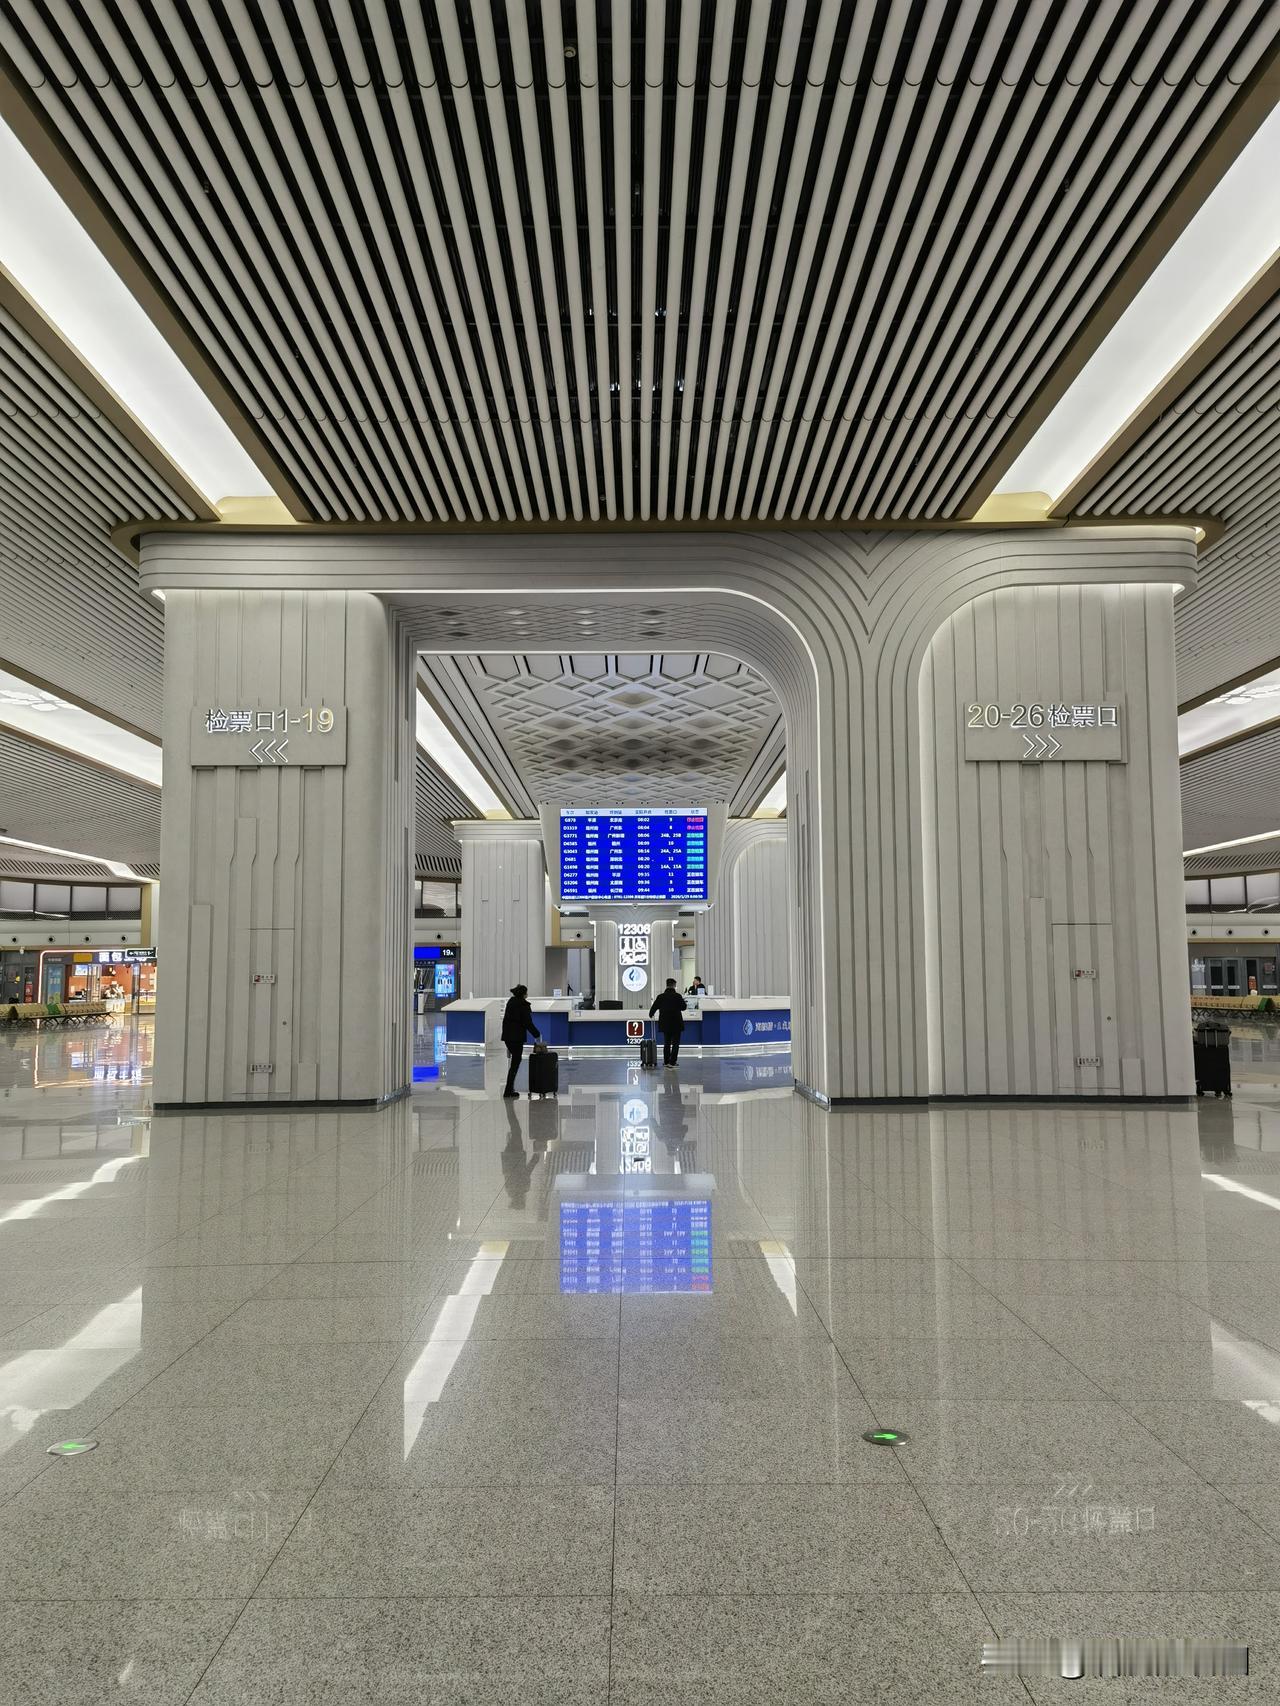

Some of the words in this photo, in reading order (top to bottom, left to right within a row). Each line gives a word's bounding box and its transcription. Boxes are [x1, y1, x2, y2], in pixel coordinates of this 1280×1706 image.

[205, 707, 335, 733] 检票口1-19
[618, 924, 651, 935] 12306
